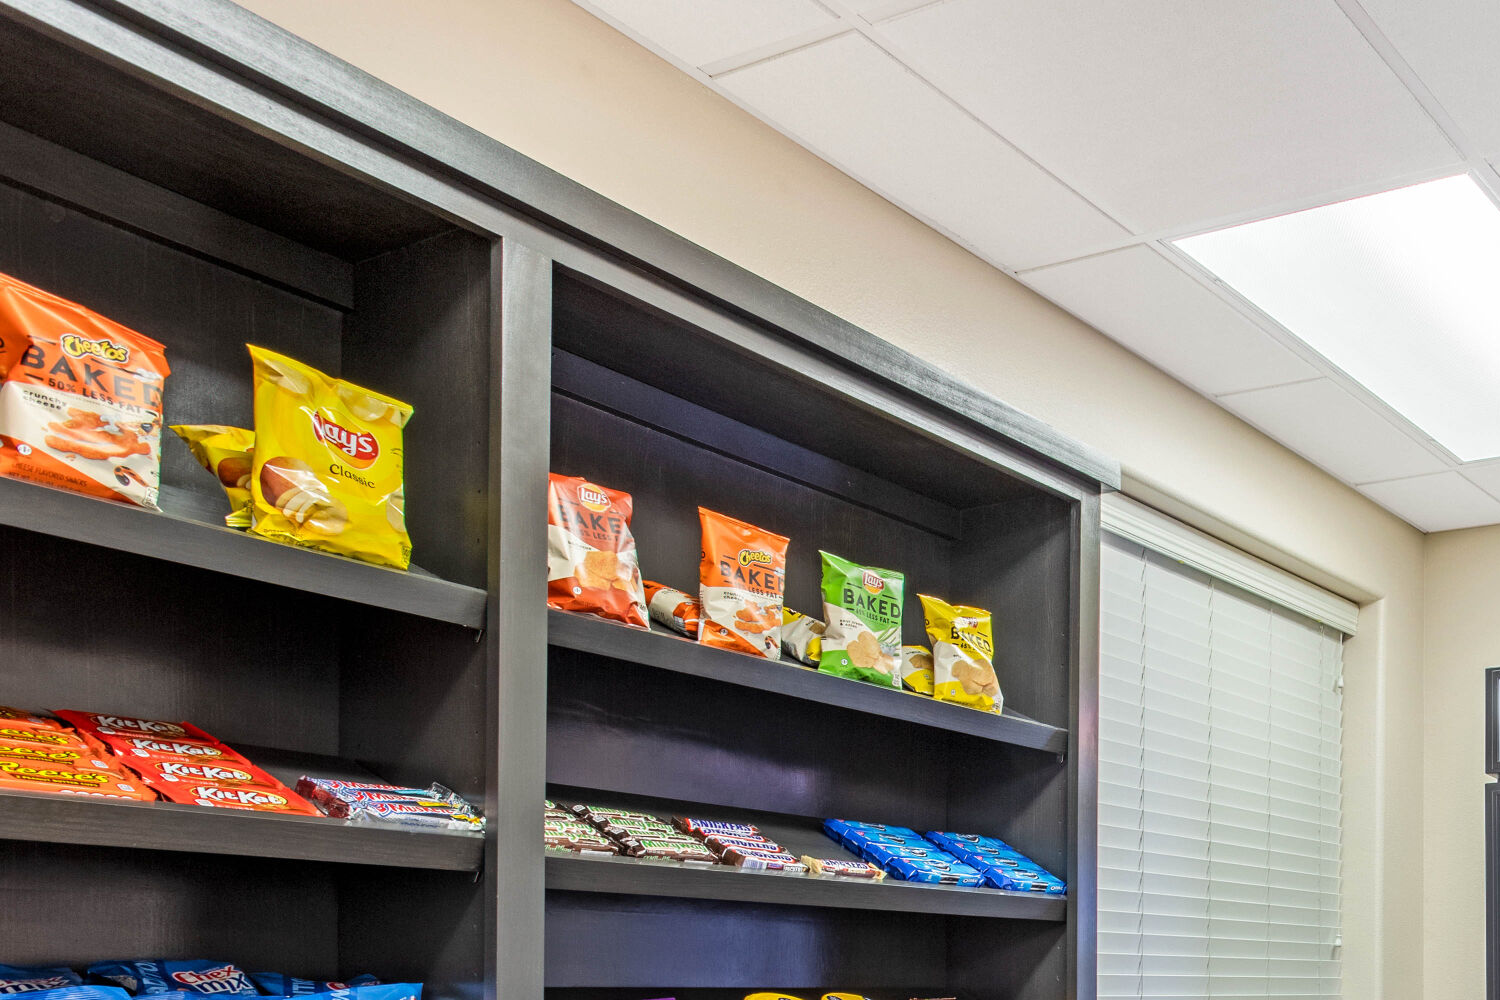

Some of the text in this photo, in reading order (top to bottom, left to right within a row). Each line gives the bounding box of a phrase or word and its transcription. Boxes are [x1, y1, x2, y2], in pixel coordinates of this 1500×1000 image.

[62, 335, 128, 362] Cheetos
[48, 378, 141, 413] 50% LESS FAT
[320, 417, 374, 457] Lay's
[329, 463, 376, 489] Classic
[580, 486, 609, 505] Lay's
[740, 550, 772, 567] Cheetos
[843, 588, 901, 619] BAKED
[880, 616, 890, 624] FAT
[173, 965, 239, 984] Chex
